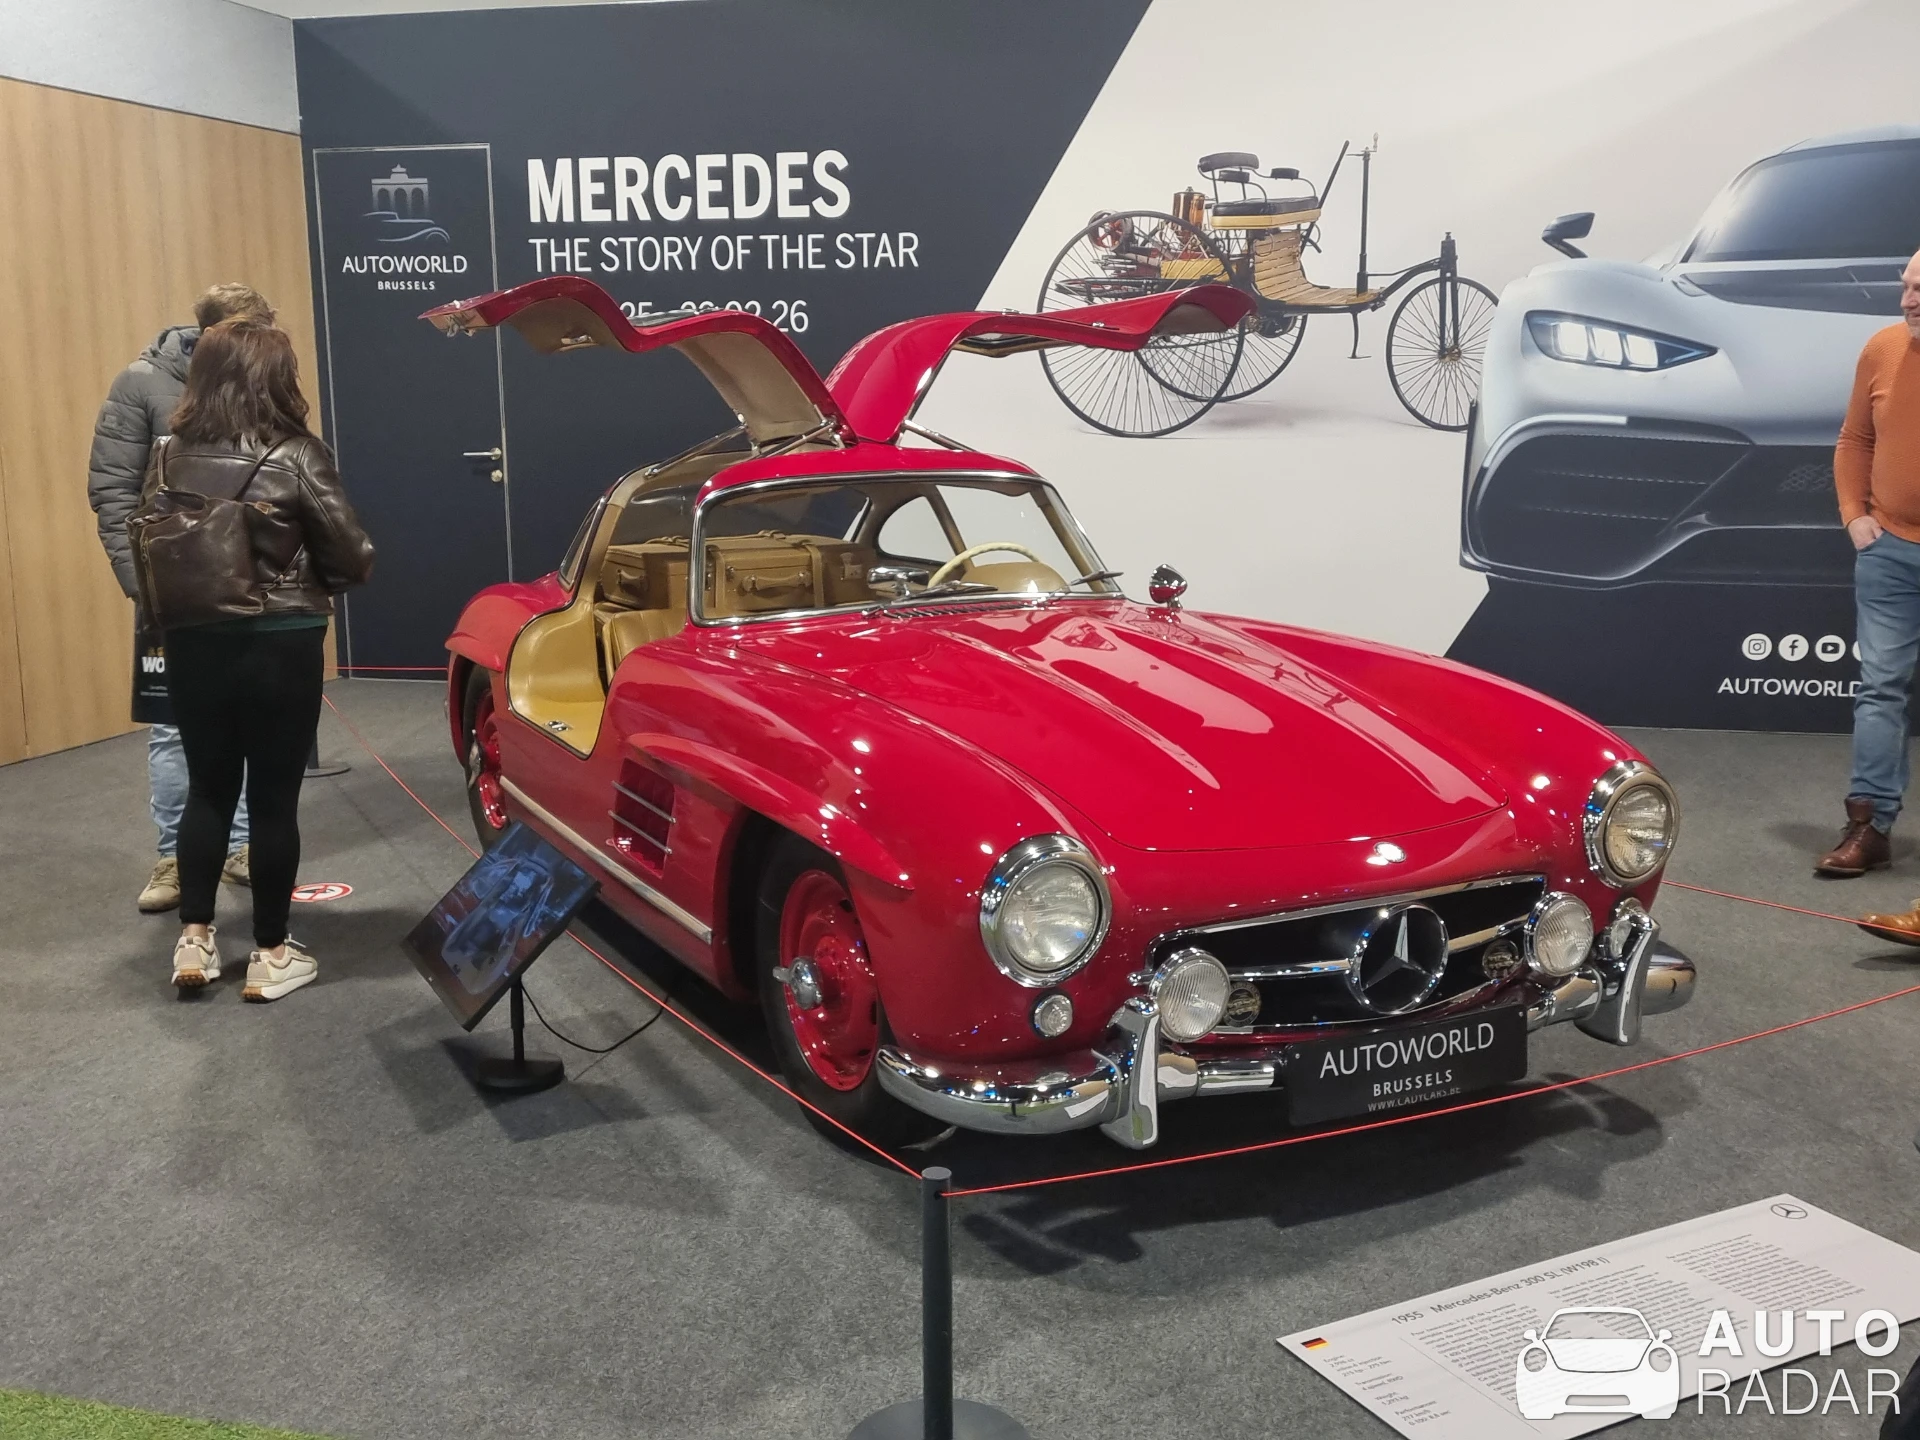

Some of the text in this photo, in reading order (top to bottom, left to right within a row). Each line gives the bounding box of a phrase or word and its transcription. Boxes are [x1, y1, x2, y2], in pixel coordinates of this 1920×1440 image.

[527, 149, 851, 223] MERCEDES
[341, 254, 468, 274] AUTOWORLD
[528, 231, 920, 273] THE STORY OF THE STAR
[377, 280, 436, 291] BRUSSELS
[1319, 1022, 1495, 1079] AUTOWORLD
[1373, 1069, 1453, 1097] BRUSSELS
[1391, 1310, 1424, 1325] 1955
[1430, 1283, 1523, 1314] Mercedes-Benz
[1520, 1275, 1546, 1287] 300
[1544, 1270, 1563, 1280] SL
